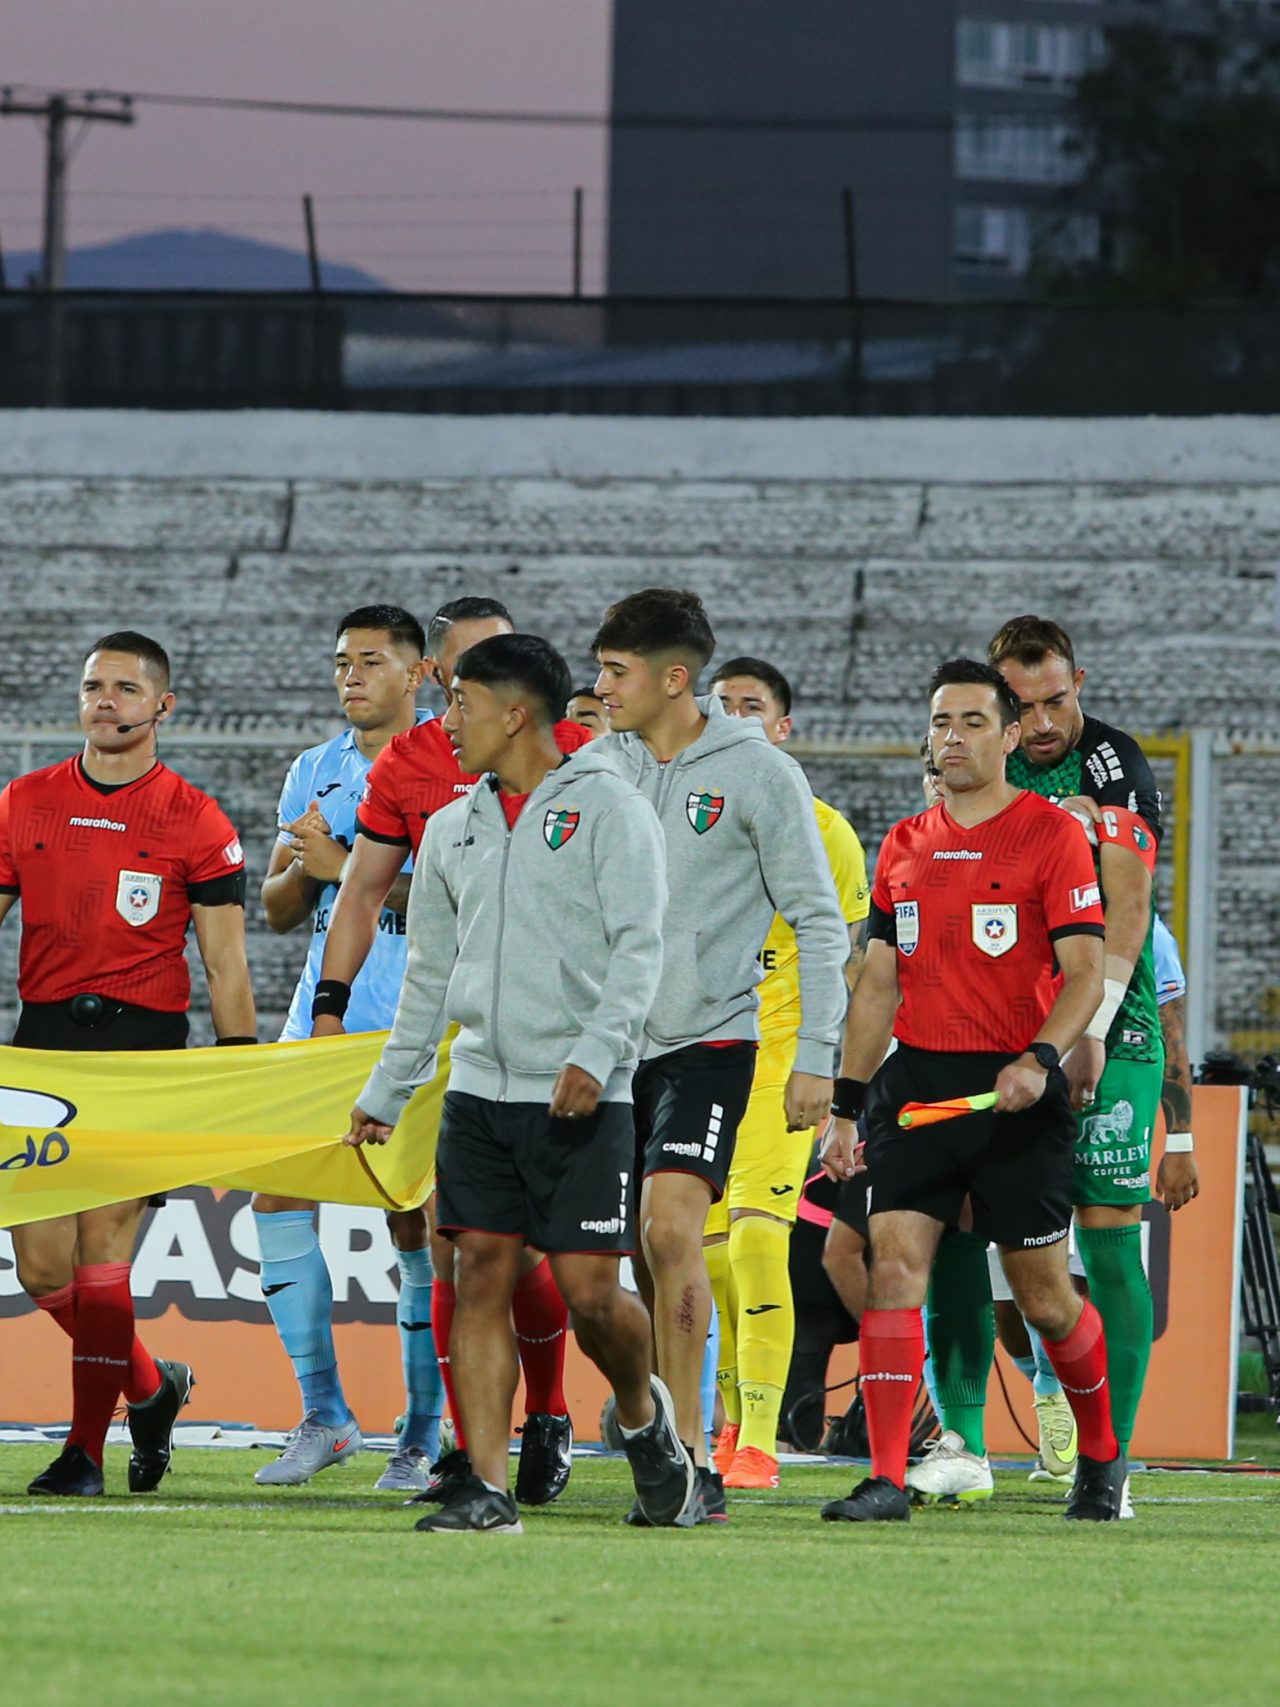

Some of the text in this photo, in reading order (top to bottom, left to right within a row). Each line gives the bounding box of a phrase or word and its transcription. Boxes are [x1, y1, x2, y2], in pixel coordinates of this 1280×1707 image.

[69, 817, 127, 832] marathon
[1103, 811, 1118, 838] C
[932, 850, 983, 861] marathon
[663, 1142, 702, 1157] capelli
[1074, 1144, 1148, 1166] MARLEY
[1093, 1166, 1132, 1177] COFFEE
[1023, 1227, 1068, 1247] marathon
